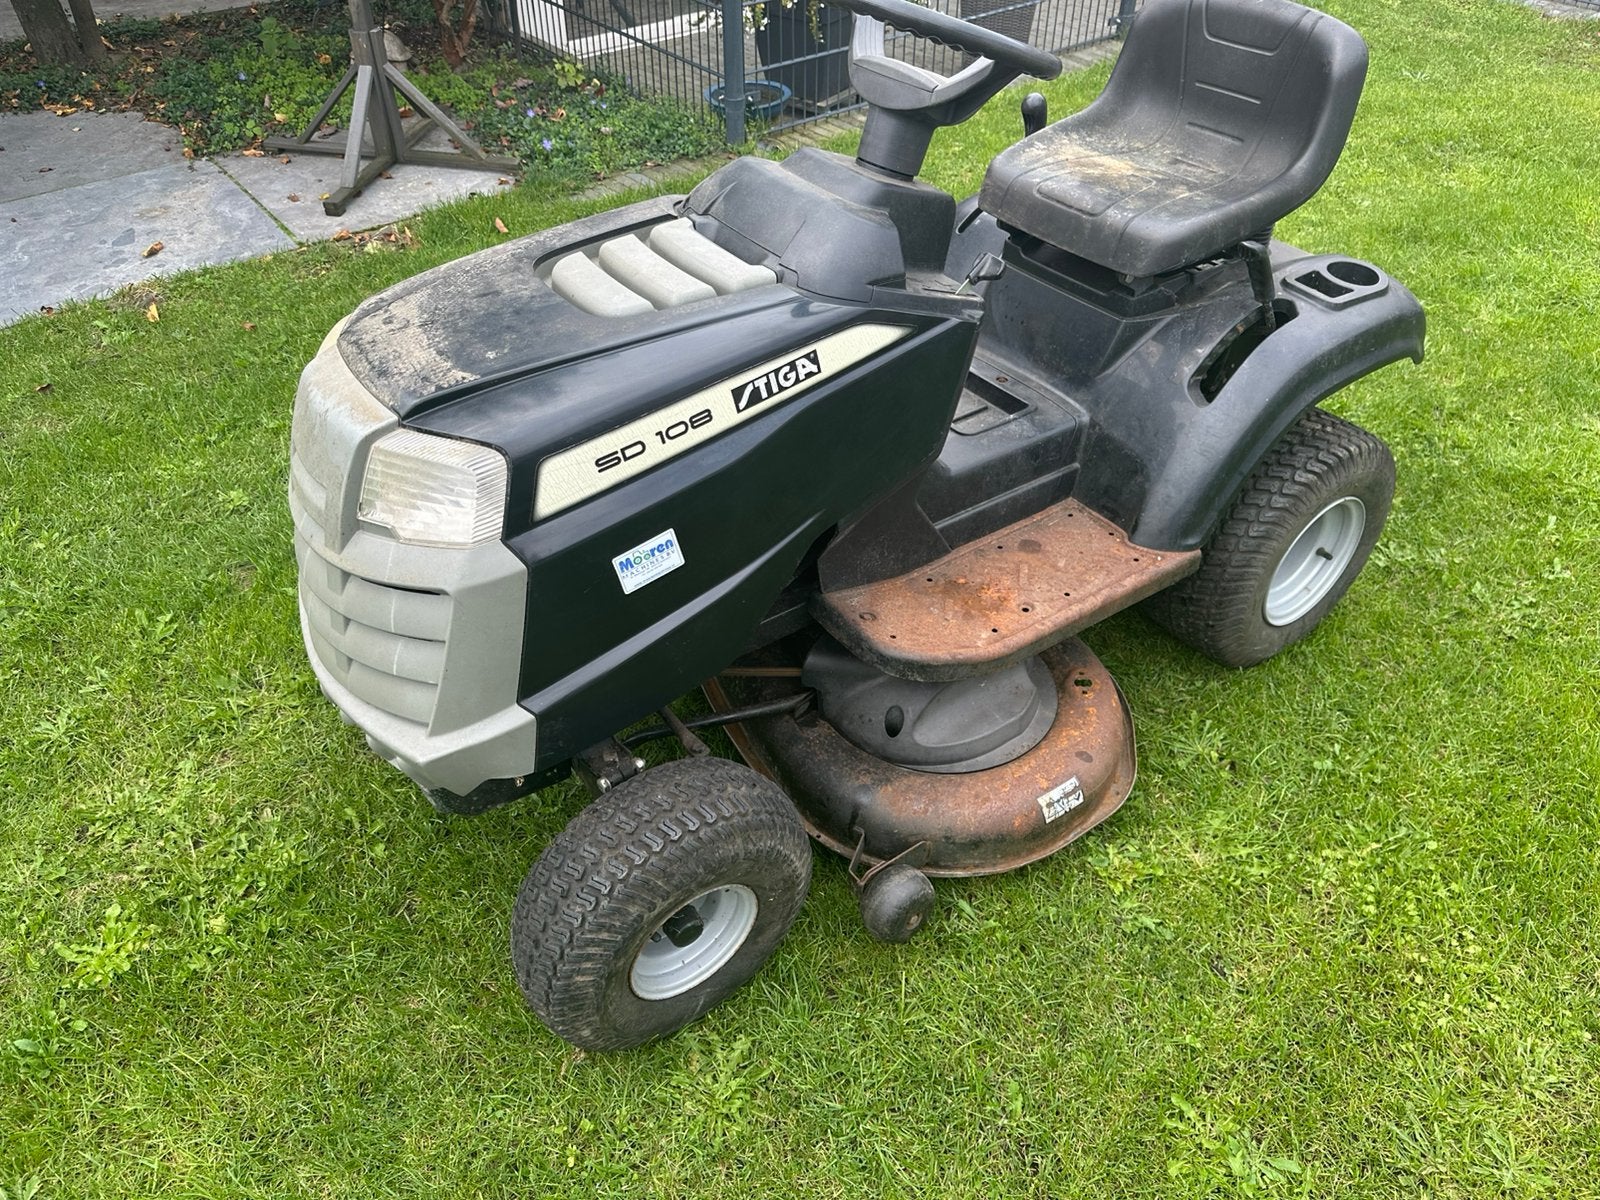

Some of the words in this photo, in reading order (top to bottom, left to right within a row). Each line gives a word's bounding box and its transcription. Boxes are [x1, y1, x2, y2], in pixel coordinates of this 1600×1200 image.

[594, 440, 646, 473] SD
[655, 408, 713, 444] 108
[738, 356, 819, 411] STIGA
[618, 539, 674, 573] Mooren
